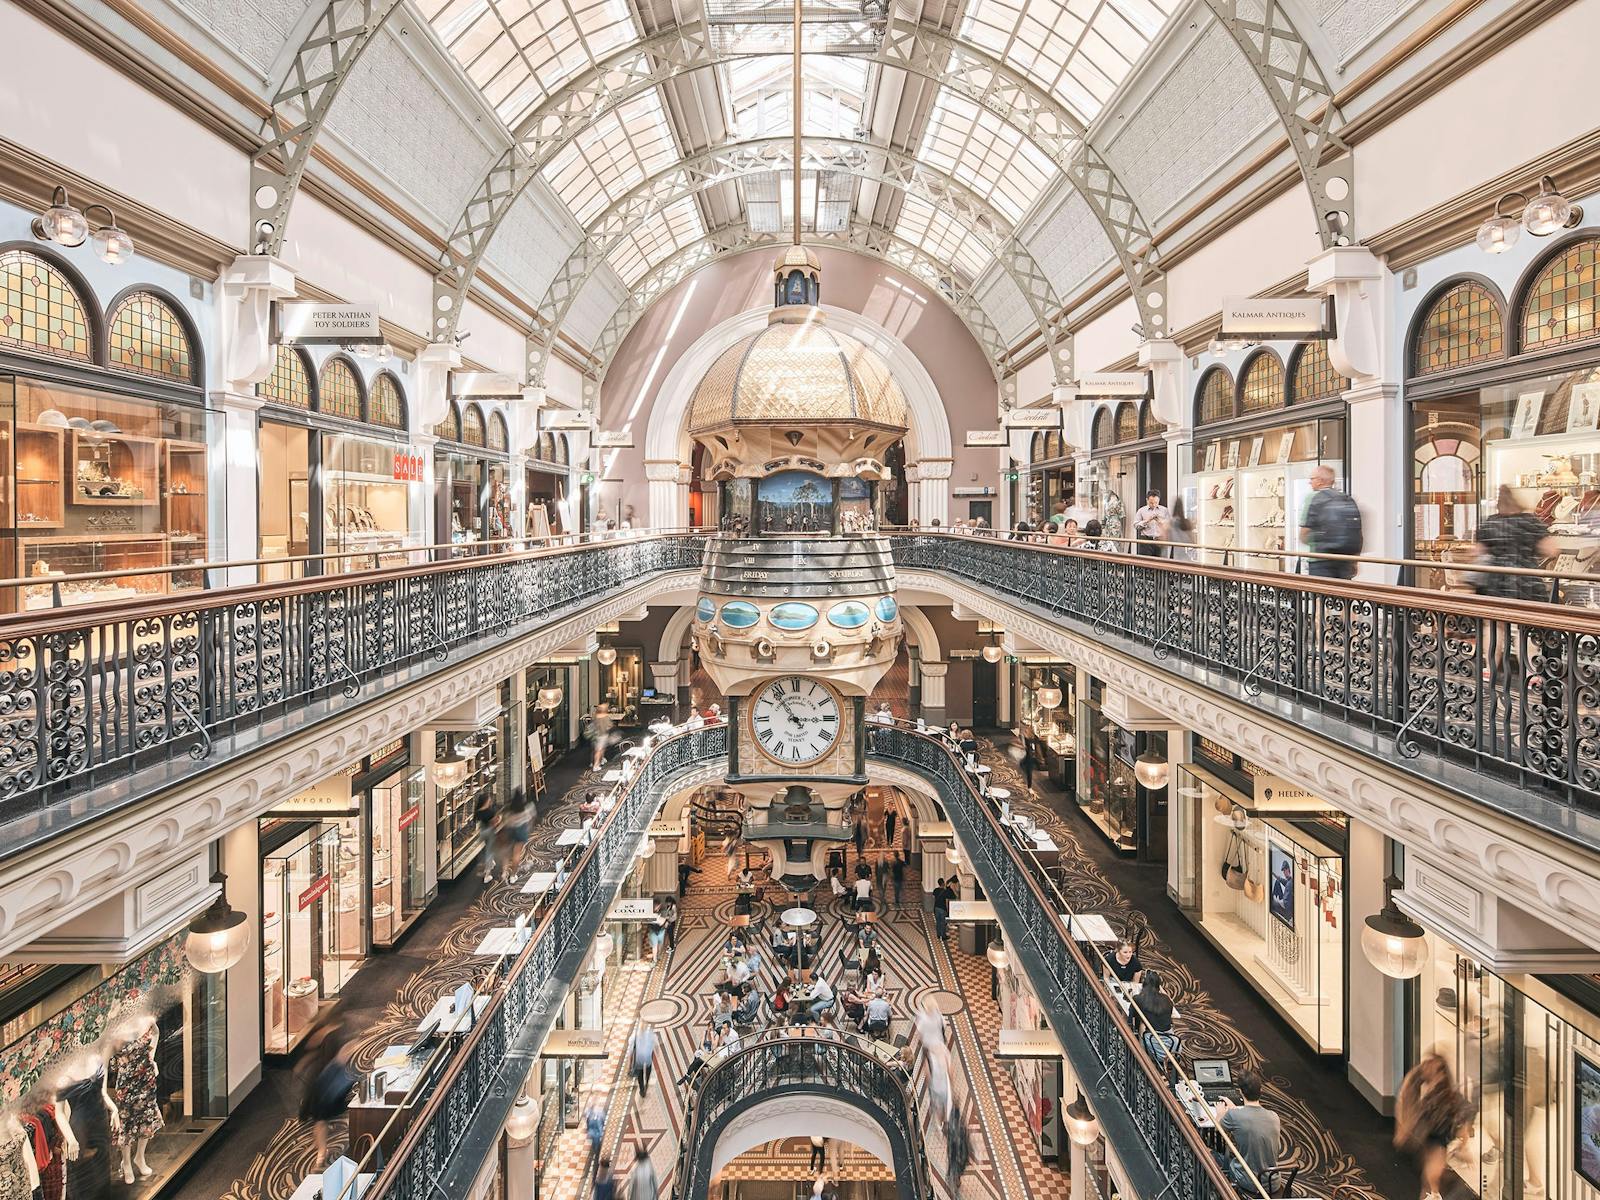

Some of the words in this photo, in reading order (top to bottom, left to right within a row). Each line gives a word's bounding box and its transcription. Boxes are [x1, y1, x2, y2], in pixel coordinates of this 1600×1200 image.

[394, 462, 423, 476] SALE
[743, 571, 768, 579] FRIDAY
[829, 570, 863, 579] SATURDAY
[791, 680, 800, 692] XII
[818, 697, 830, 707] II
